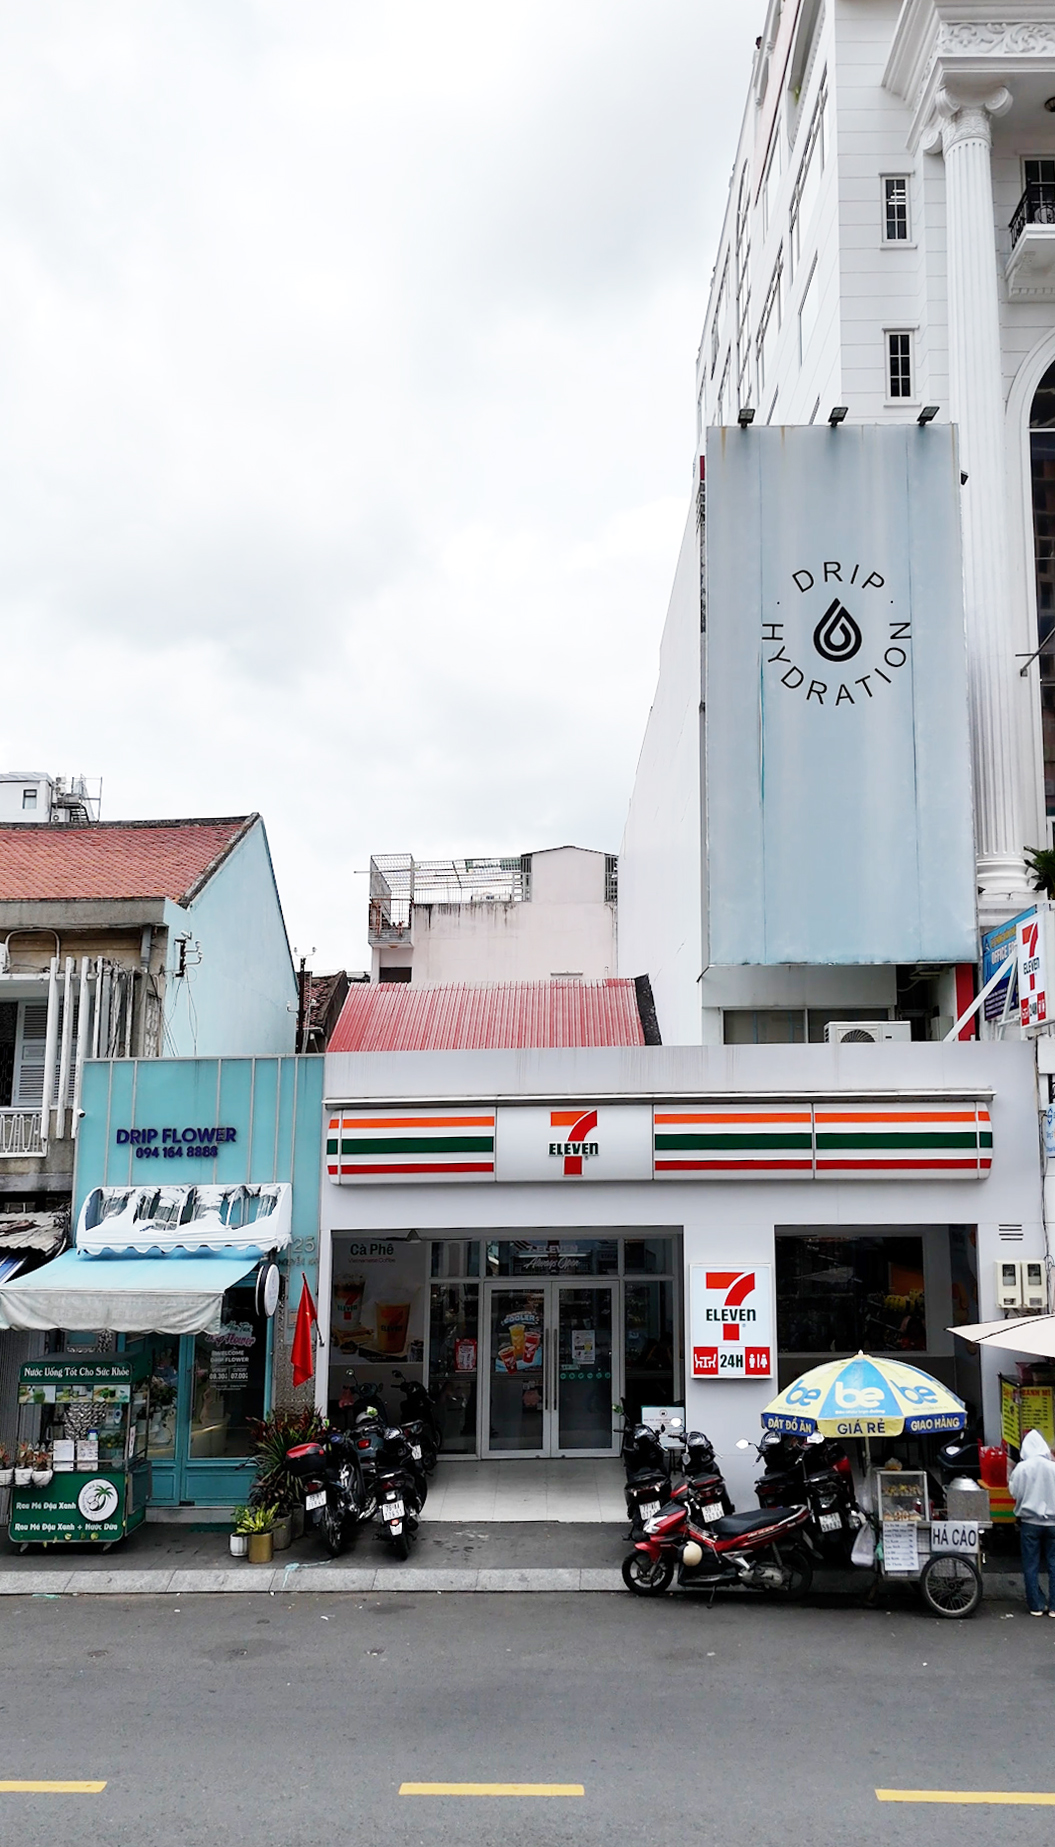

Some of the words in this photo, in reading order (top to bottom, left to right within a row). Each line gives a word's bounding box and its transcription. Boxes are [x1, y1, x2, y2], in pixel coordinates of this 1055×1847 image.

[792, 562, 885, 592] DRIP
[762, 622, 911, 706] HYDRATION
[116, 1128, 158, 1144] DRIP
[162, 1127, 237, 1144] FLOWER
[136, 1147, 159, 1158] 094
[162, 1146, 183, 1158] 164
[186, 1145, 218, 1158] 8888
[350, 1243, 367, 1255] Cà
[370, 1243, 394, 1255] Phê
[720, 1354, 744, 1368] 24H
[64, 1367, 77, 1376] Tốt
[79, 1367, 94, 1377] Cho
[785, 1380, 822, 1407] be
[834, 1381, 885, 1409] be
[889, 1379, 939, 1405] be
[799, 1420, 813, 1434] ĂN
[837, 1419, 861, 1435] GIÁ
[866, 1418, 886, 1434] RẺ
[910, 1419, 934, 1431] GIAO
[934, 1415, 960, 1429] HÀNG
[58, 1502, 77, 1510] Xanh
[57, 1523, 75, 1531] Xanh
[932, 1524, 949, 1546] HÁ
[952, 1525, 977, 1547] CÀO
